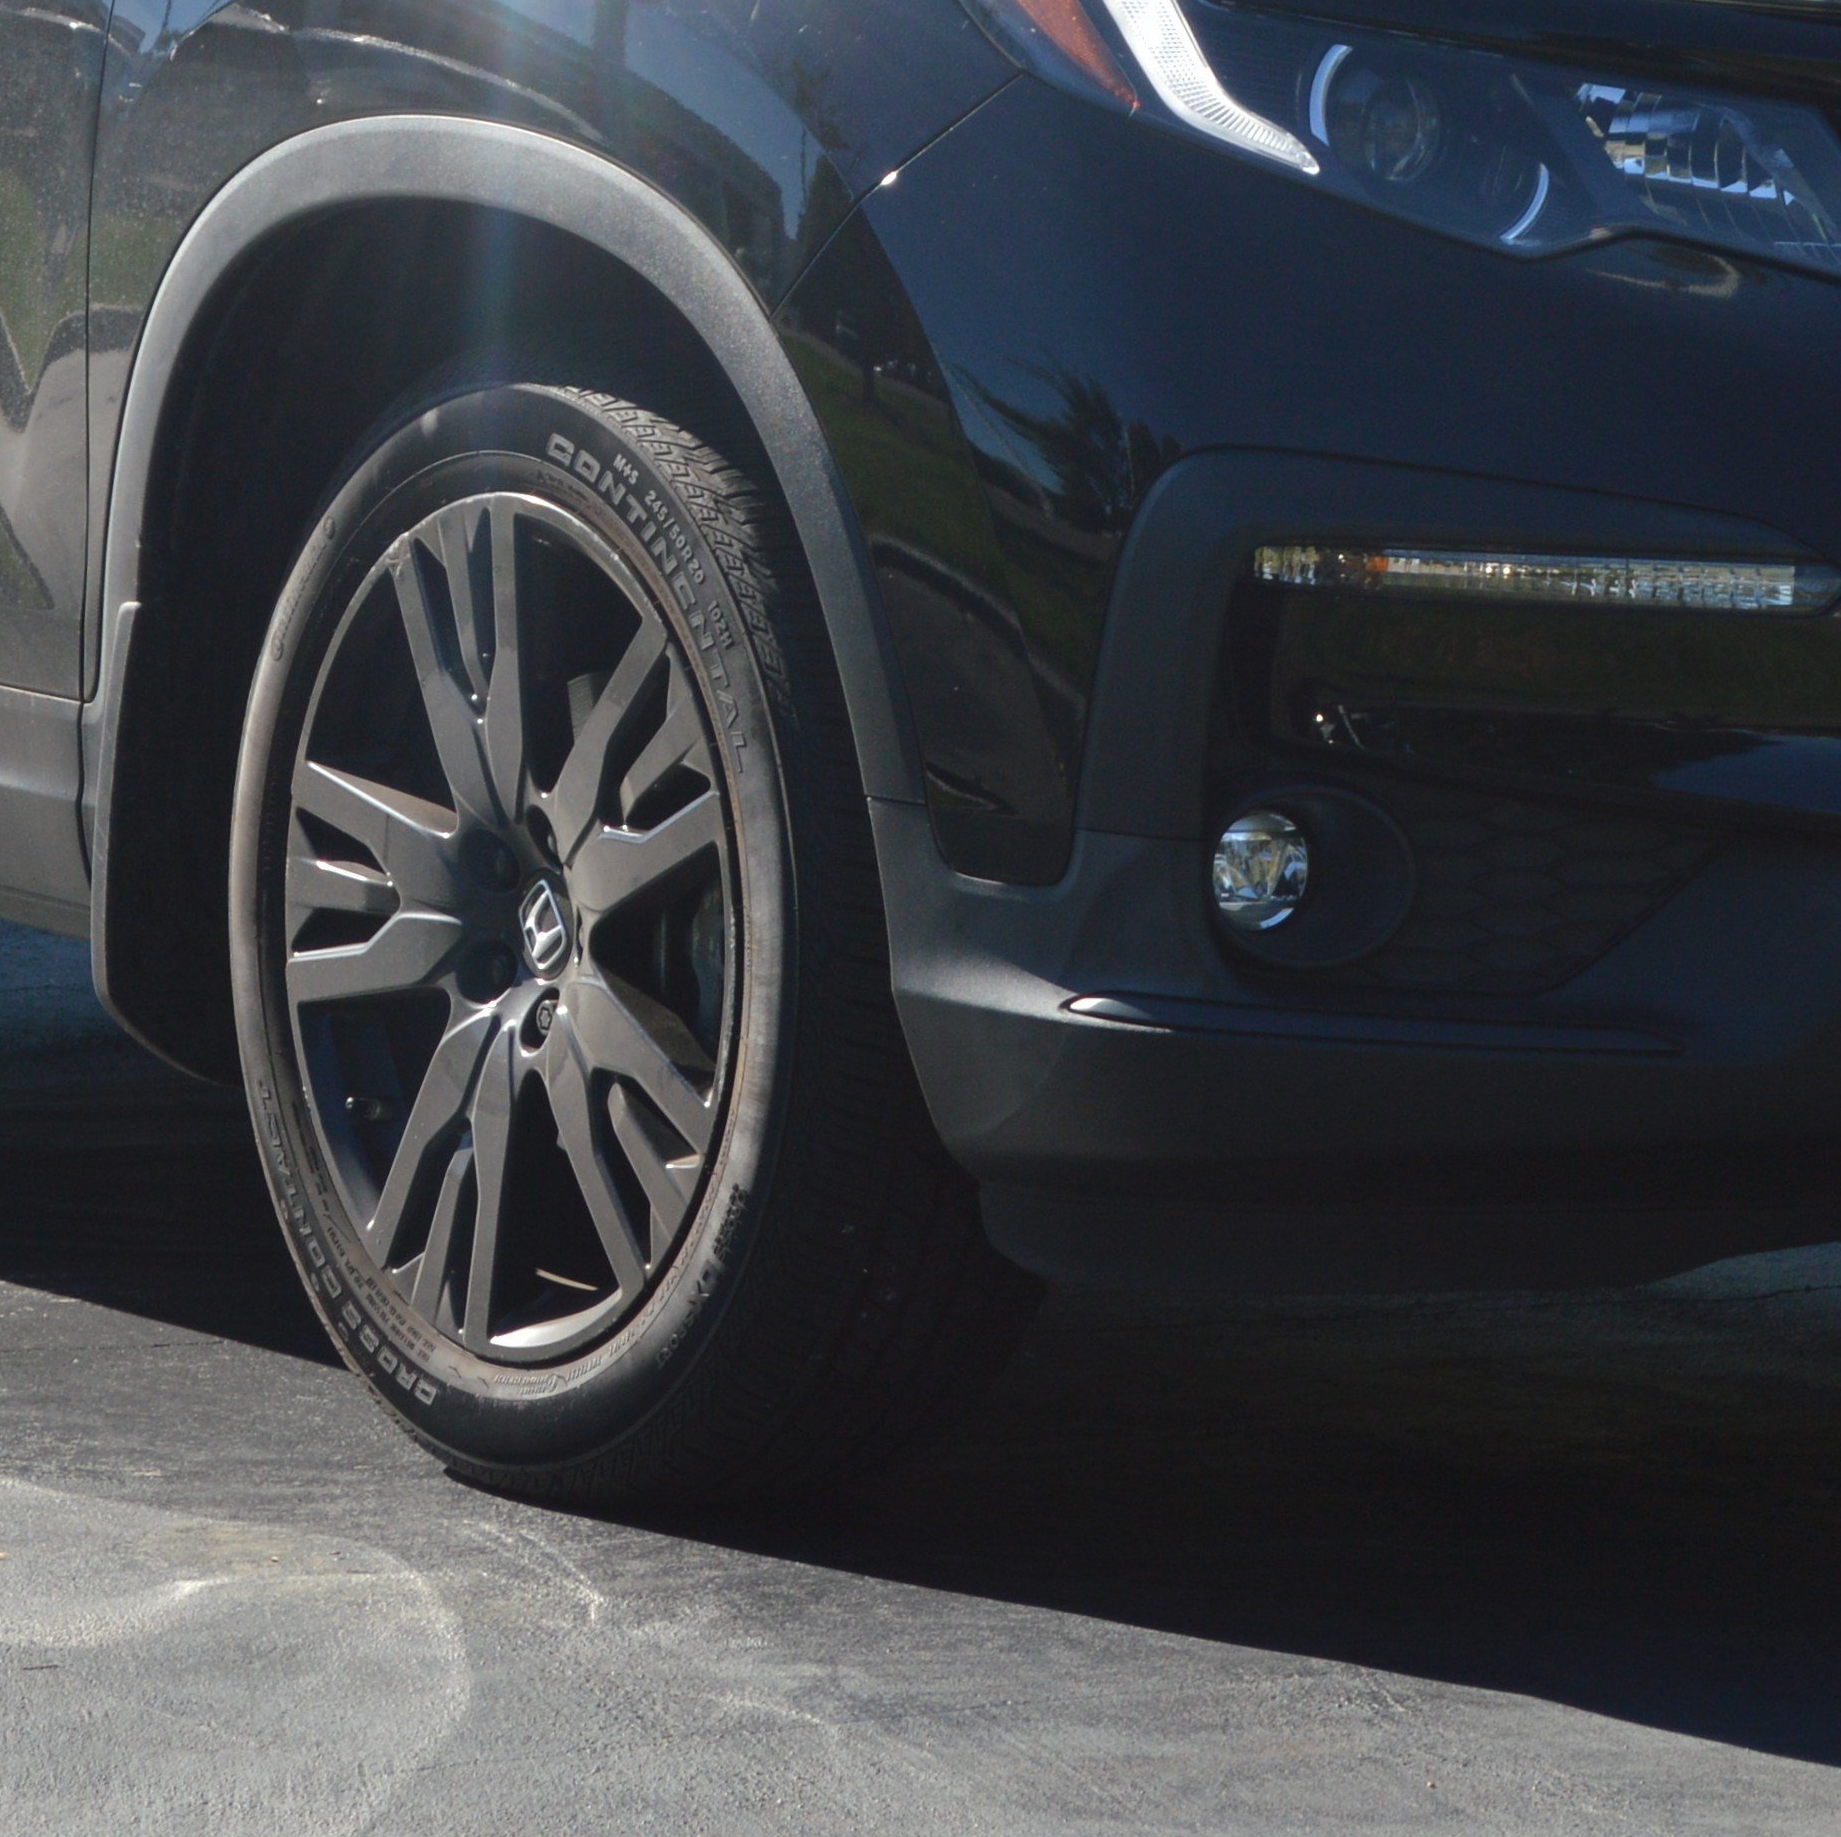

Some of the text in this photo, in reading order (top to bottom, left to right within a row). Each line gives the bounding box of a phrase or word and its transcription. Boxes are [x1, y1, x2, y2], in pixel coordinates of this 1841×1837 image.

[546, 431, 745, 775] CONTINENTAL
[612, 452, 735, 651] M+S 245/50R20 102H
